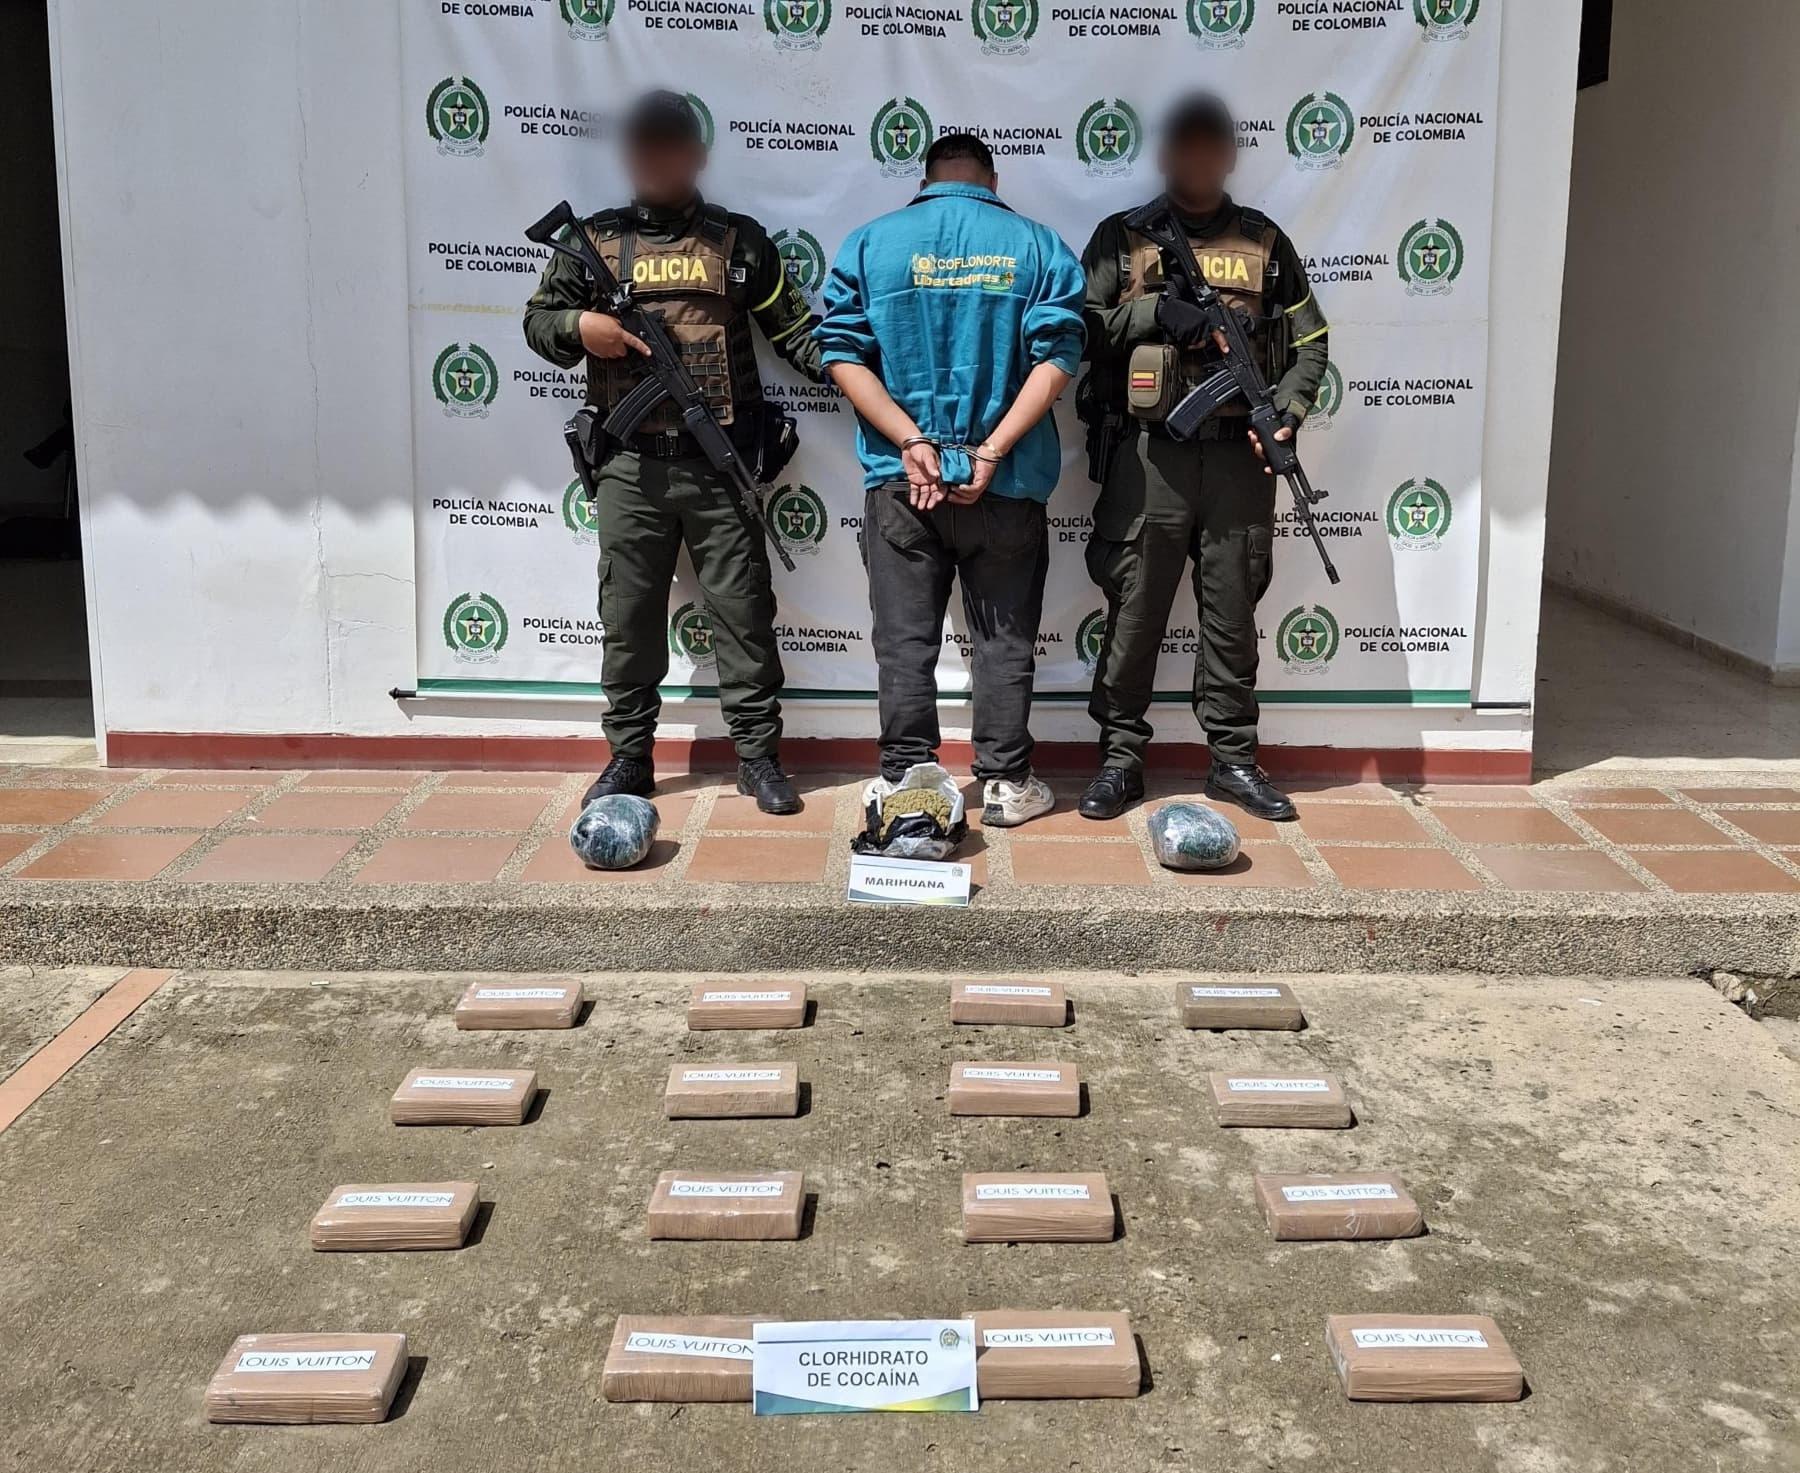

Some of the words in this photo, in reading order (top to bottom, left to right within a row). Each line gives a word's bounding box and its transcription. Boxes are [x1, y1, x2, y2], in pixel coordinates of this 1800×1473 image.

[441, 3, 461, 14] DE
[464, 4, 534, 17] COLOMBIA
[684, 2, 755, 15] NACIONAL
[845, 5, 892, 20] POLICÍA
[895, 6, 963, 22] NACIONAL
[1052, 5, 1105, 21] POLICÍA
[1109, 7, 1177, 20] NACIONAL
[1278, 0, 1328, 15] POLICÍA
[1333, 0, 1404, 13] NACIONAL
[645, 17, 663, 28] DE
[667, 17, 739, 31] COLOMBIA
[1292, 19, 1310, 31] DE
[1314, 16, 1387, 30] COLOMBIA
[861, 24, 880, 36] DE
[883, 23, 946, 38] COLOMBIA
[1068, 24, 1087, 37] DE
[1090, 24, 1160, 36] COLOMBIA
[504, 104, 556, 119] POLICÍA
[1360, 112, 1410, 128] POLICÍA
[1414, 112, 1484, 125] NACIONAL
[521, 122, 539, 134] DE
[729, 118, 782, 134] POLICÍA
[786, 122, 855, 136] NACIONAL
[993, 127, 1063, 140] NACIONAL
[1373, 132, 1391, 143] DE
[1395, 129, 1466, 142] COLOMBIA
[746, 137, 764, 149] DE
[768, 138, 839, 152] COLOMBIA
[986, 144, 1046, 156] OLOMBIA
[428, 241, 480, 256] POLICÍA
[490, 245, 550, 259] NACIONAL
[445, 259, 463, 270] DE
[467, 260, 537, 274] COLOMBIA
[937, 255, 1017, 269] COFLONORTE
[1321, 254, 1390, 268] NACIONAL
[633, 258, 708, 283] OLICIA
[513, 369, 566, 384] POLICÍA
[1349, 377, 1401, 391] POLICÍA
[1404, 379, 1473, 390] NACIONAL
[530, 386, 548, 397] DE
[552, 387, 587, 399] COLO
[789, 386, 844, 399] NACION
[1364, 395, 1382, 406] DE
[1386, 394, 1455, 406] COLOMBIA
[775, 401, 841, 413] OLOMBIA
[432, 497, 485, 511] POLICÍA
[488, 500, 555, 514] NACIONAL
[450, 514, 467, 525] DE
[471, 515, 539, 528] COLOMBIA
[1312, 511, 1380, 523] NACIONAL
[1059, 532, 1076, 542] DE
[1273, 527, 1289, 537] DE
[1293, 526, 1362, 537] COOMBIA
[523, 617, 573, 630] POLICÍA
[798, 627, 863, 640] NACIONAL
[1344, 625, 1395, 638] POLICÍA
[1399, 627, 1467, 638] NACIONAL
[539, 633, 556, 643] DE
[560, 634, 604, 645] COLOM
[781, 641, 848, 652] COLOMBIA
[1161, 643, 1178, 653] DE
[1360, 642, 1377, 652] DE
[1381, 642, 1450, 652] COLOMBIA
[865, 877, 945, 889] MARIHUANA
[672, 1185, 713, 1193] LOUIS
[719, 1185, 782, 1193] VUITTON
[1023, 1187, 1088, 1195] VUITTON
[1330, 1188, 1395, 1196] VUITTON
[340, 1195, 381, 1203] OUIS
[387, 1195, 453, 1203] VUITTON
[628, 1337, 677, 1349] LOUIS
[985, 1333, 1033, 1343] LOUIS
[1039, 1332, 1113, 1342] VUITTON
[1355, 1333, 1405, 1343] LOUIS
[1408, 1333, 1484, 1343] VUITTON
[238, 1357, 289, 1367] LOUIS
[296, 1355, 373, 1366] VUITTON
[799, 1350, 929, 1367] CLORHIDRATO
[807, 1372, 833, 1388] DE
[837, 1369, 919, 1388] COCAÍNA
